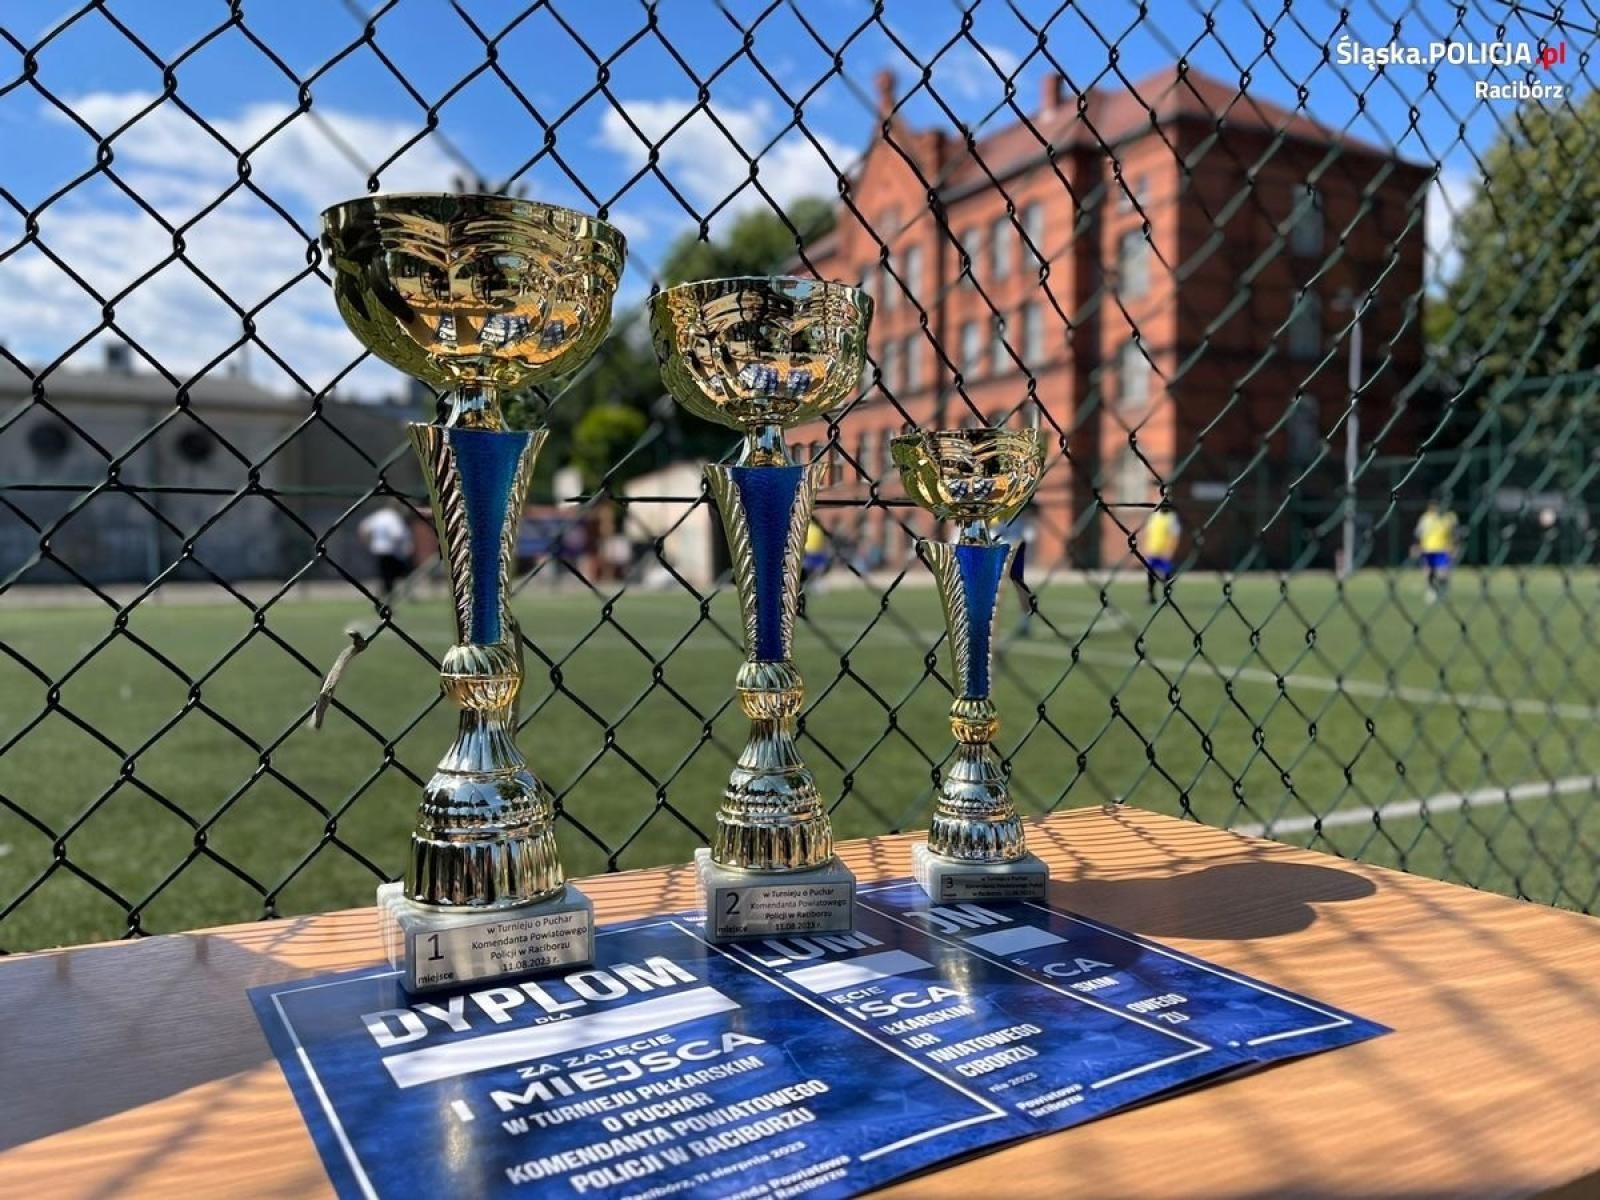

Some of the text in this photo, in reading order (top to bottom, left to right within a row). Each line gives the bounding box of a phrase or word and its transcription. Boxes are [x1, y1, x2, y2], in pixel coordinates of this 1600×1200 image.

[726, 891, 740, 915] 2
[810, 887, 834, 897] Puchar
[751, 901, 797, 910] Komendanta
[487, 926, 495, 934] w
[498, 920, 533, 933] Turnieju
[543, 914, 573, 926] Puchar
[427, 934, 445, 961] 1
[471, 926, 588, 950] Komendanta Powiatowego
[490, 941, 570, 960] Policji w Raciborzu
[502, 958, 550, 972] 11.08.2023
[418, 971, 454, 985] miejsce
[360, 956, 698, 1049] DYPLOM
[535, 1012, 573, 1025] DLA
[516, 1033, 677, 1079] ZA ZAJĘCIE
[490, 1031, 767, 1112] MIEJSCA
[501, 1055, 765, 1136] W TURNIEJU PIŁKARSKIM
[601, 1091, 716, 1133] O PUCHAR
[504, 1079, 830, 1186] KOMENDANTA POWIATOWEGO
[569, 1106, 817, 1194] POLICJI W RACIBORZU
